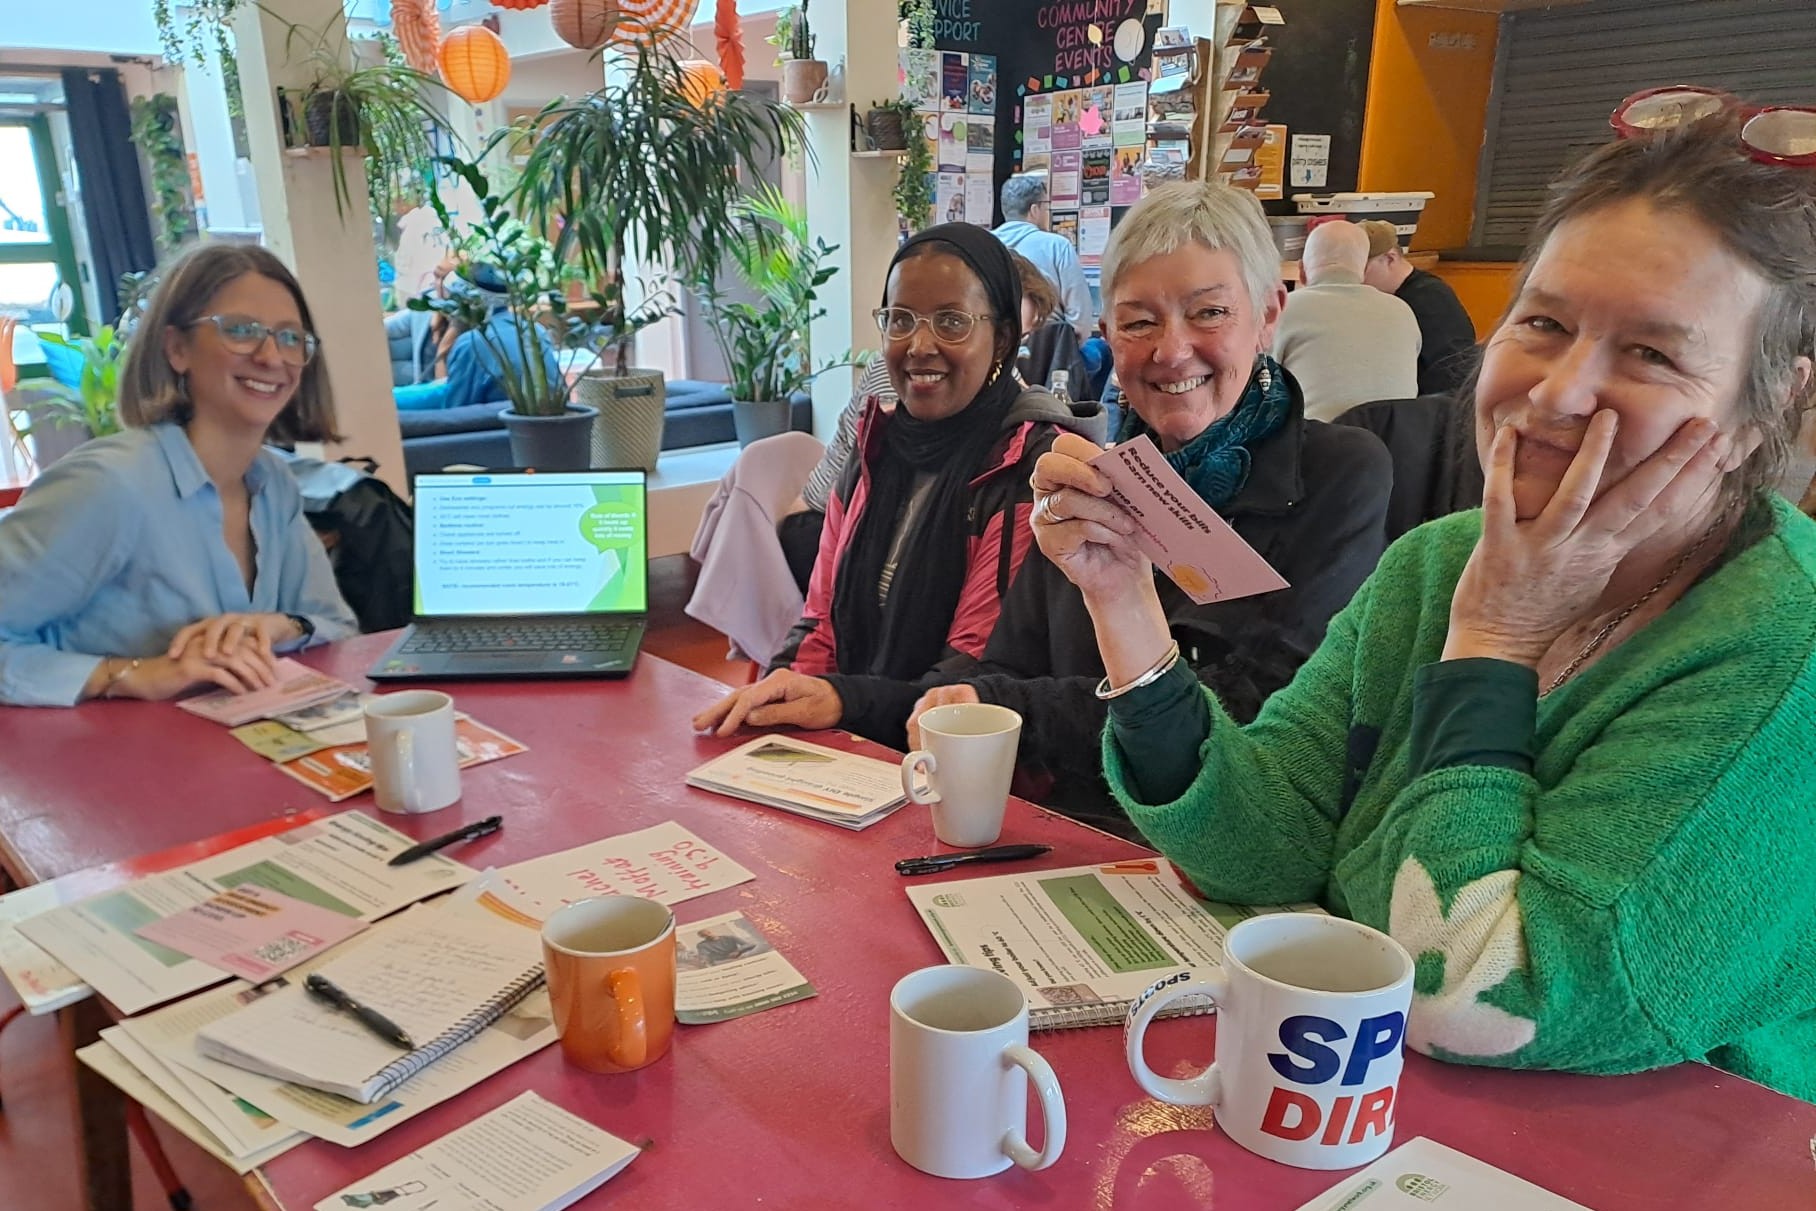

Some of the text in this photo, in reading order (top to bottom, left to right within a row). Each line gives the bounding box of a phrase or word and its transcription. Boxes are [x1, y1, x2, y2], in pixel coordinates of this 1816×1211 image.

[1038, 0, 1135, 28] COMMUNITY
[1055, 45, 1113, 72] EVENTS
[1118, 451, 1195, 531] Learn new skills
[1128, 447, 1212, 535] Reduce your bills
[565, 867, 620, 899] achel
[648, 848, 710, 891] training
[1146, 923, 1164, 935] down
[976, 943, 996, 956] tips
[1159, 935, 1192, 962] temperature
[1267, 1011, 1406, 1086] SP
[1260, 1086, 1396, 1146] DIR
